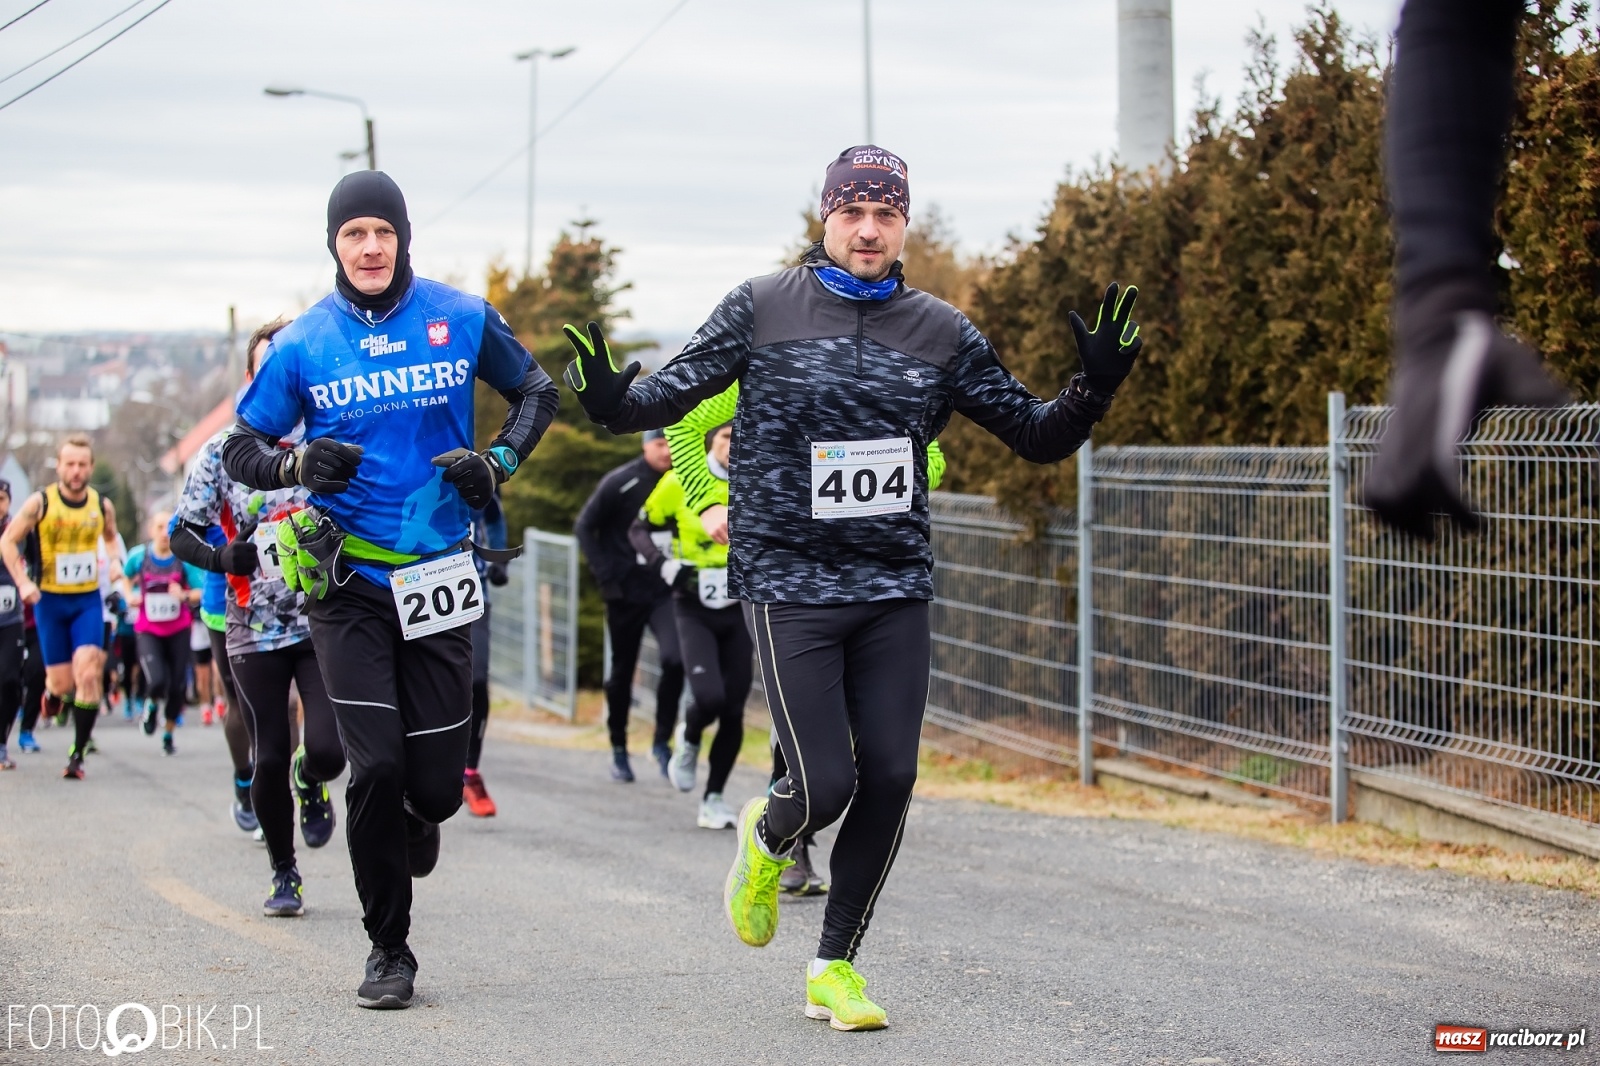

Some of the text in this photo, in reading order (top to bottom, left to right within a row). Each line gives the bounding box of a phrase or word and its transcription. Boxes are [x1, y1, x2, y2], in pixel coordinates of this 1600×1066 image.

[852, 155, 903, 174] GDYNIA
[425, 315, 448, 323] POLAND
[308, 358, 470, 410] RUNNERS
[412, 394, 449, 408] TEAM
[849, 446, 909, 457] www.personalbest.pl
[817, 465, 908, 504] 404
[60, 562, 93, 579] 171
[402, 577, 480, 627] 202
